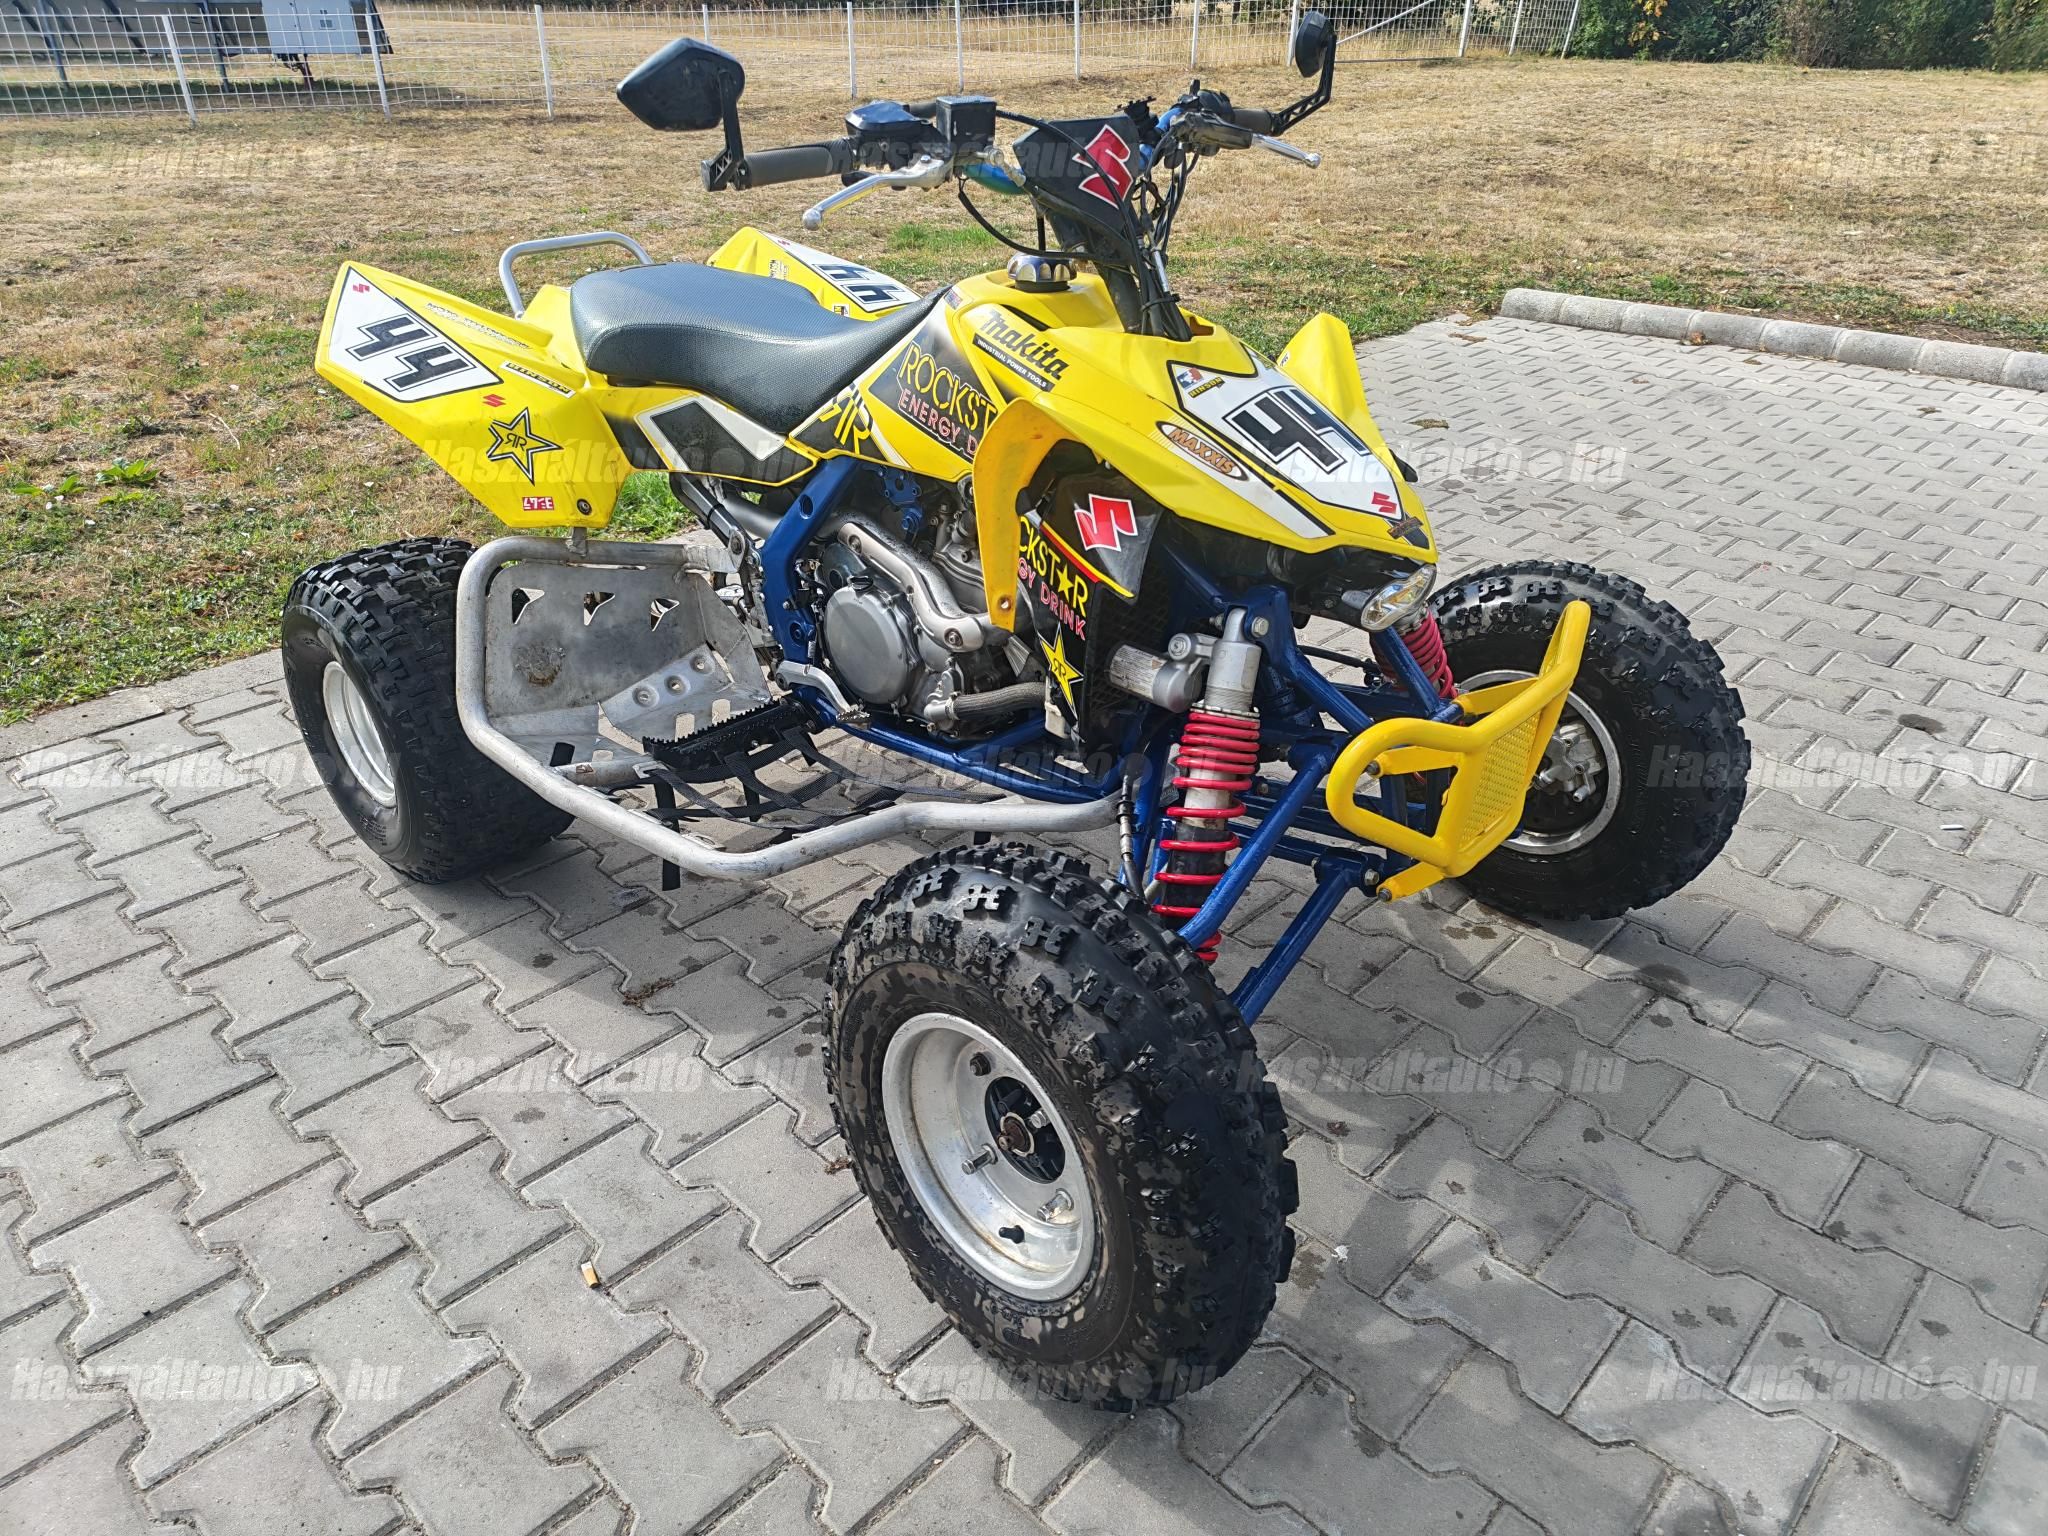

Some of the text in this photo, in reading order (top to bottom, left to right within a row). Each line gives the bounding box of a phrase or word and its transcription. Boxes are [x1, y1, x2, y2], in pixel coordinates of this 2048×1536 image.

[346, 313, 476, 393] 44
[977, 339, 1048, 388] INDUSTRIAL POWER TOOLS
[899, 388, 961, 444] ENERGY
[1223, 385, 1370, 475] 44
[1168, 426, 1236, 476] MAXXIS
[1040, 581, 1087, 641] DRINK
